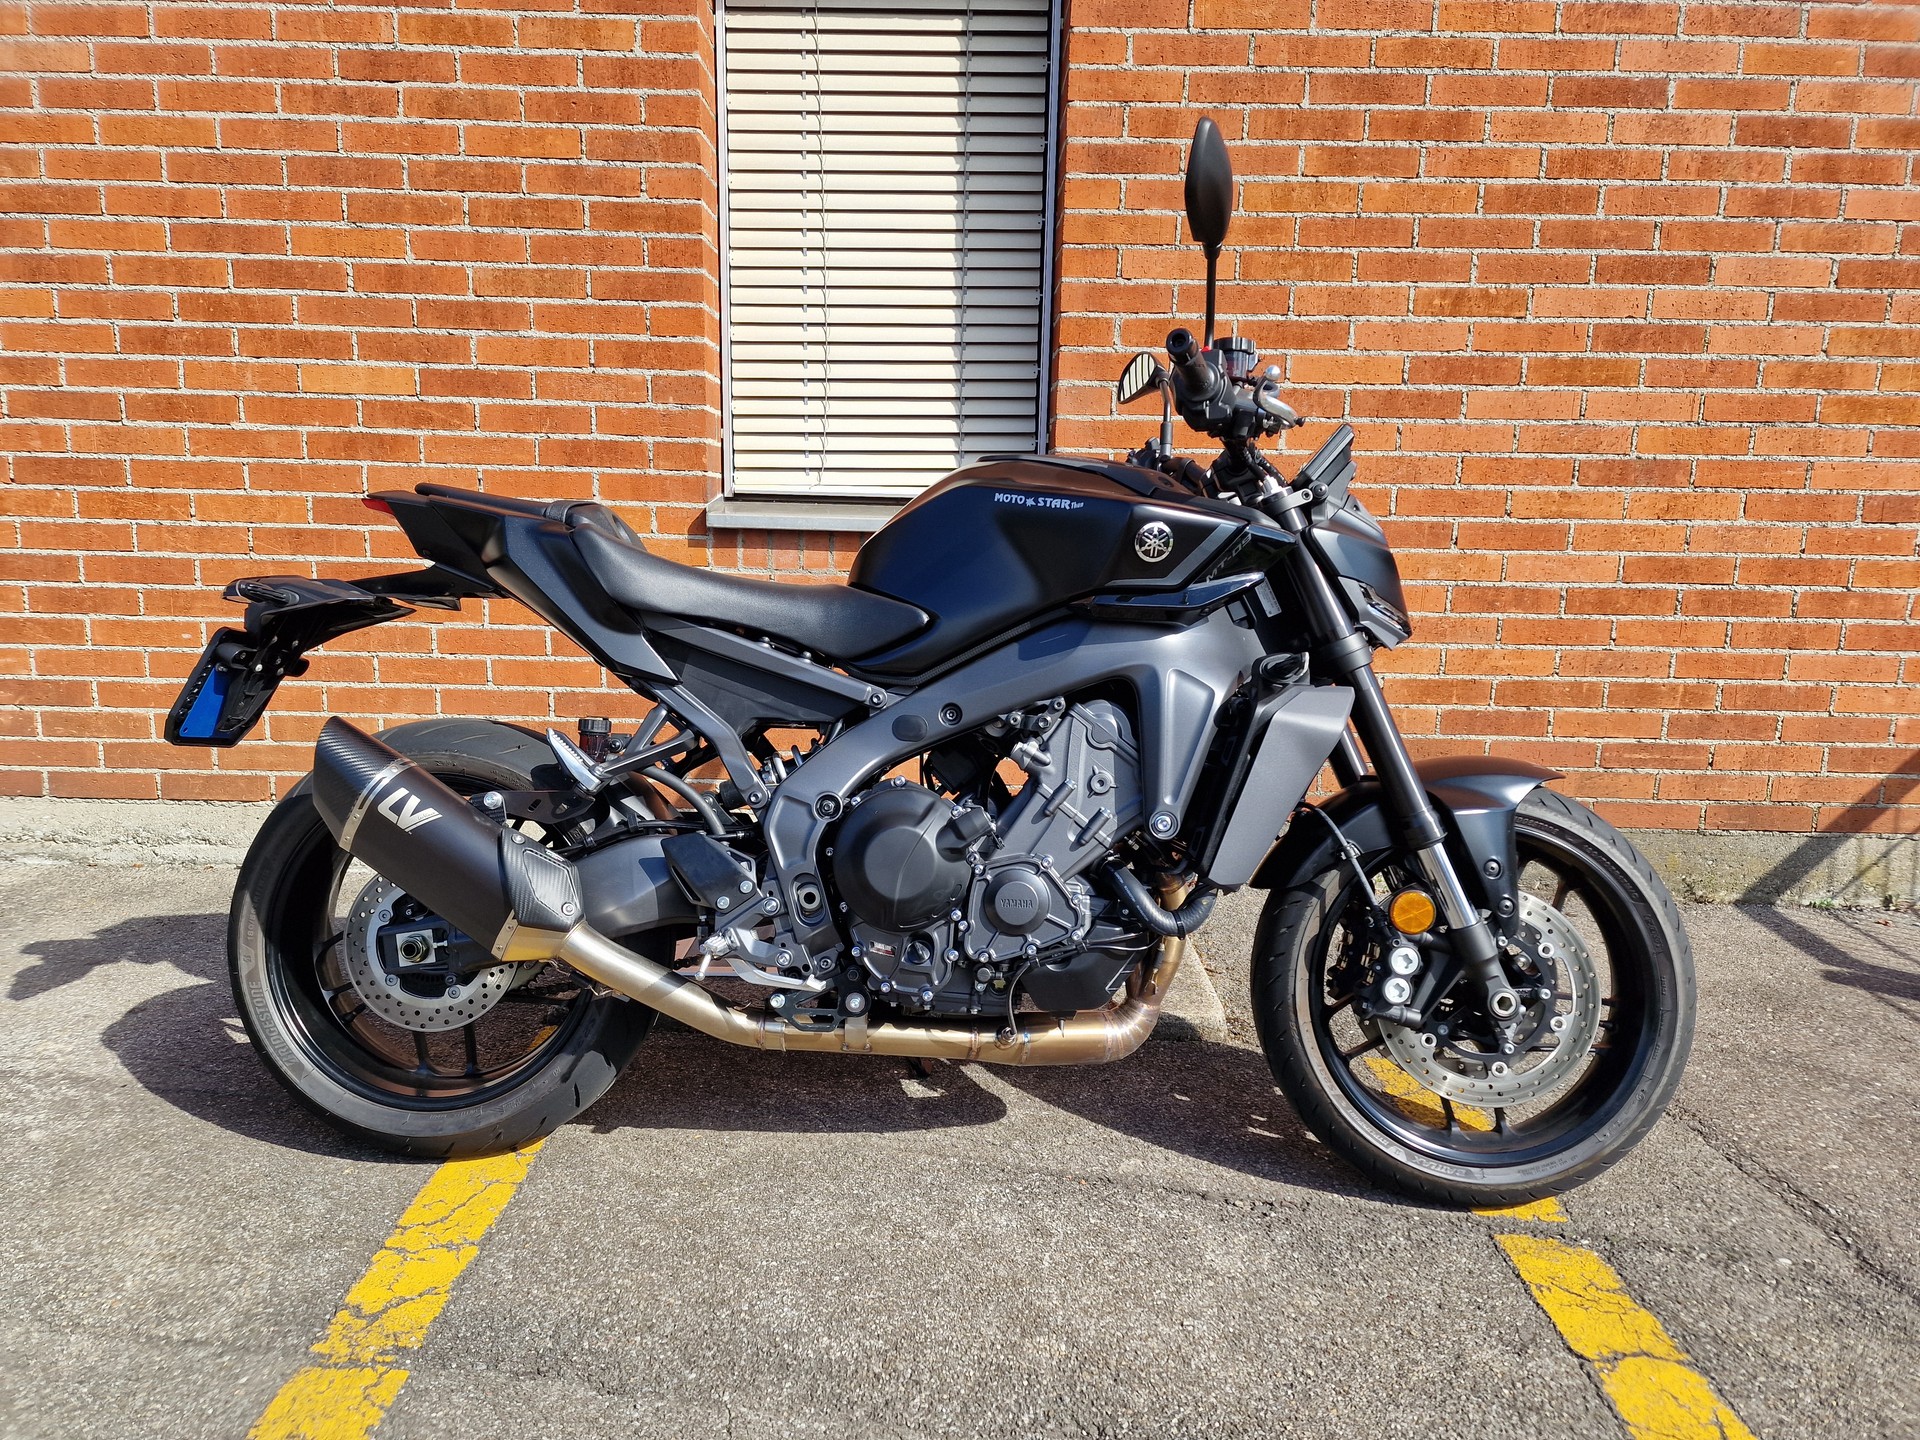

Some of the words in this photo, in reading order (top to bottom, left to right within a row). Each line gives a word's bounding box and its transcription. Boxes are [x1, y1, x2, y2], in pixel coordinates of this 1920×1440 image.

[994, 492, 1025, 504] MOTO
[1037, 497, 1070, 510] STAR
[1206, 533, 1252, 584] MT-09
[377, 787, 443, 833] LV
[1000, 898, 1033, 909] YAMAHA
[249, 980, 299, 1067] BRIDGESTONE
